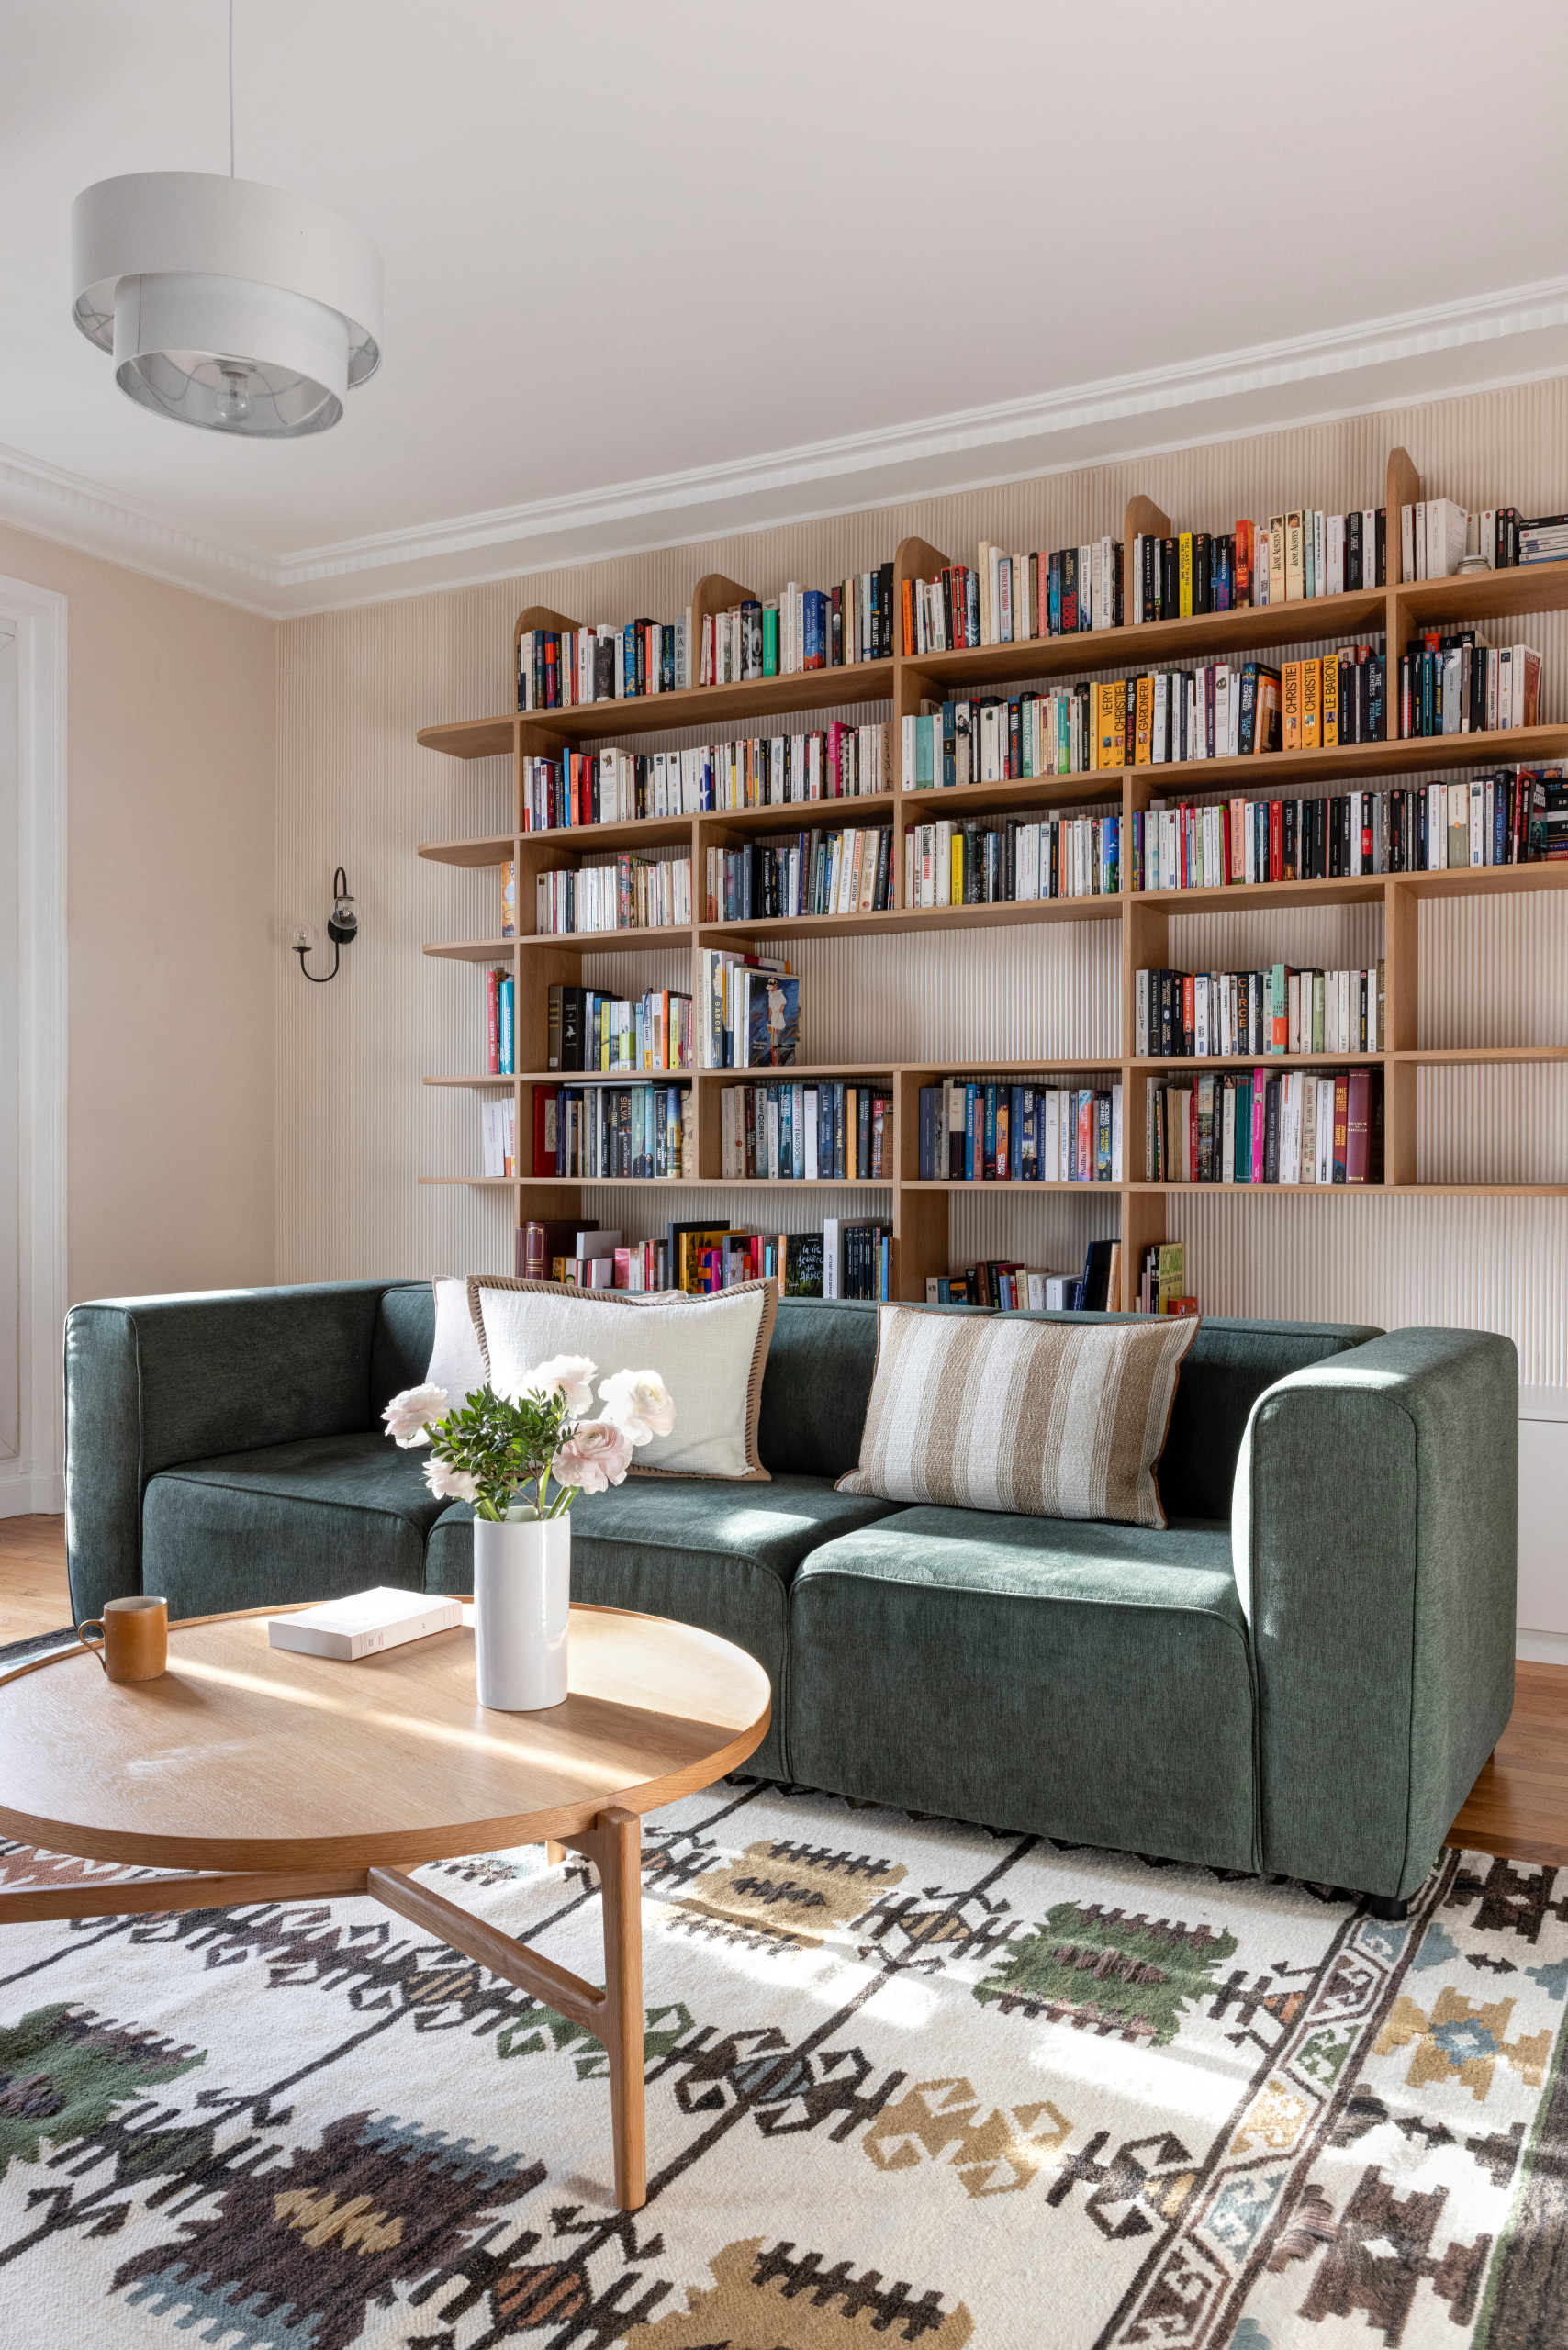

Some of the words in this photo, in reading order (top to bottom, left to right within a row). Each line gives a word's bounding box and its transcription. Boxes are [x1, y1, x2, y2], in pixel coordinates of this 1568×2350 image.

[1062, 597, 1071, 629] BLOOD
[1285, 667, 1297, 714] CHRISTIE
[1304, 665, 1316, 711] CHRISTIE
[1325, 660, 1336, 694] BARON
[1138, 685, 1149, 731] GARDNER
[1326, 698, 1336, 709] LE
[620, 1096, 628, 1122] SILVA
